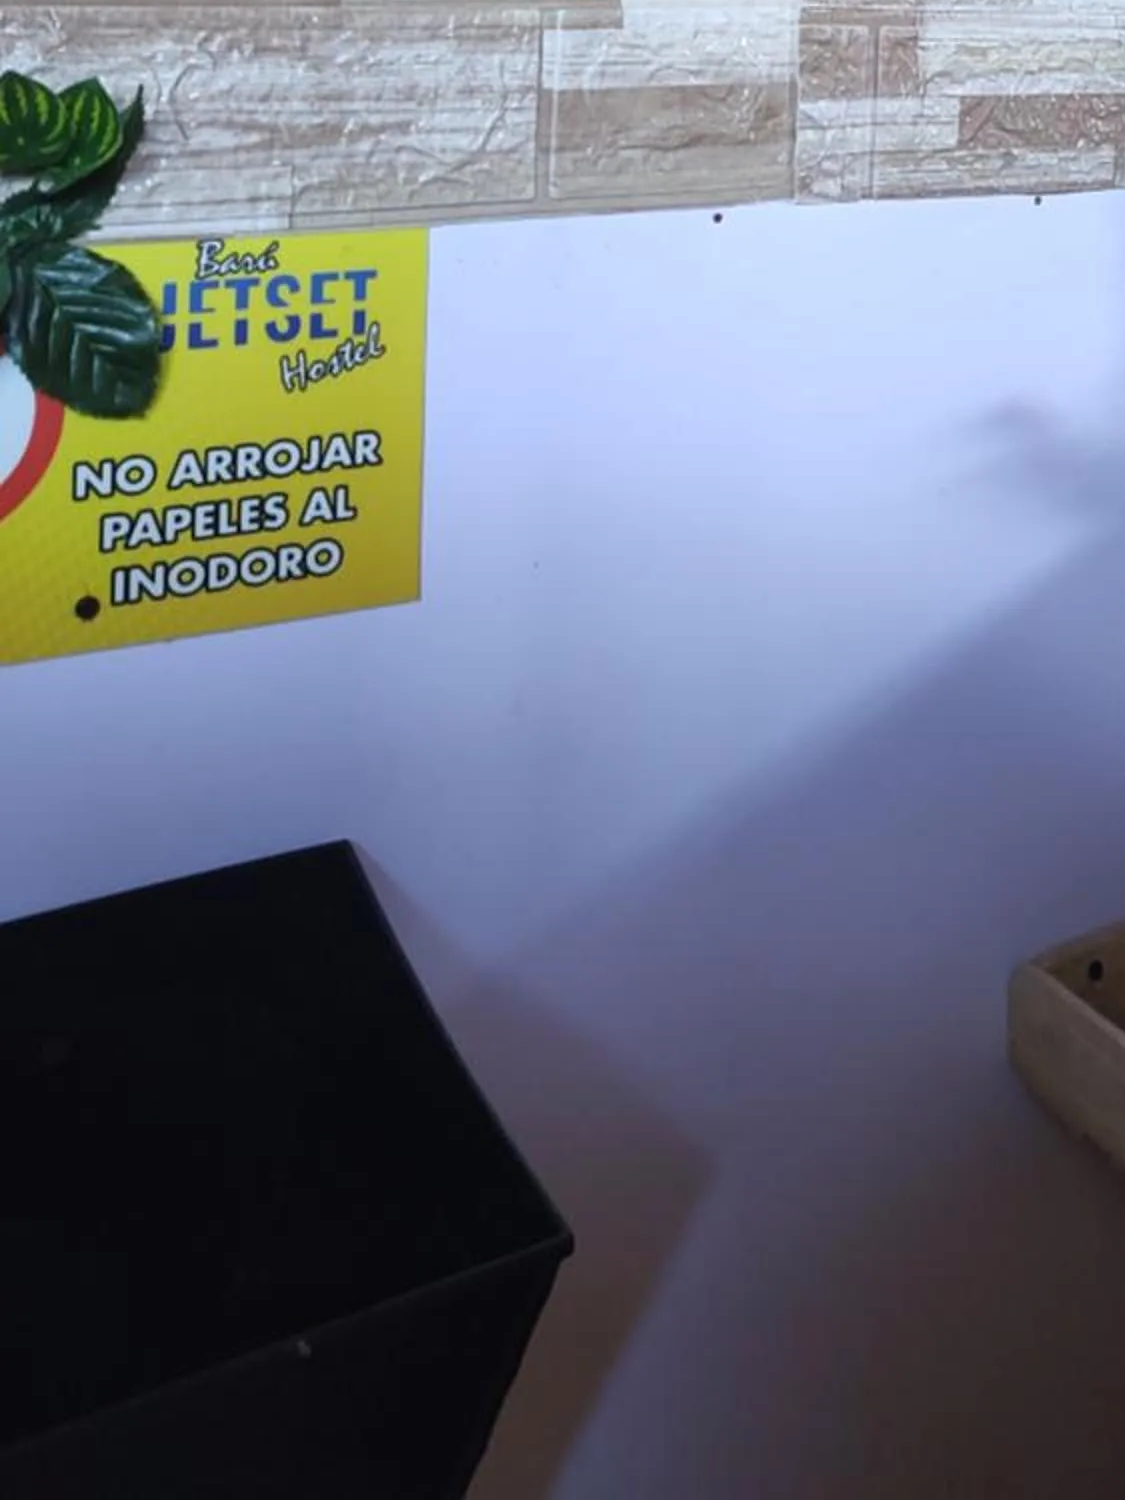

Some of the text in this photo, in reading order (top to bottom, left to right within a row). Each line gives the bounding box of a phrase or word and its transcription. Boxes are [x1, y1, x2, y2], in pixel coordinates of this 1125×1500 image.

[195, 238, 280, 278] Barú
[160, 269, 378, 354] JETSET
[280, 321, 386, 393] Hostel
[73, 430, 383, 500] NO ARROJAR
[99, 484, 357, 552] PAPELES AL
[111, 537, 344, 605] INODORO
